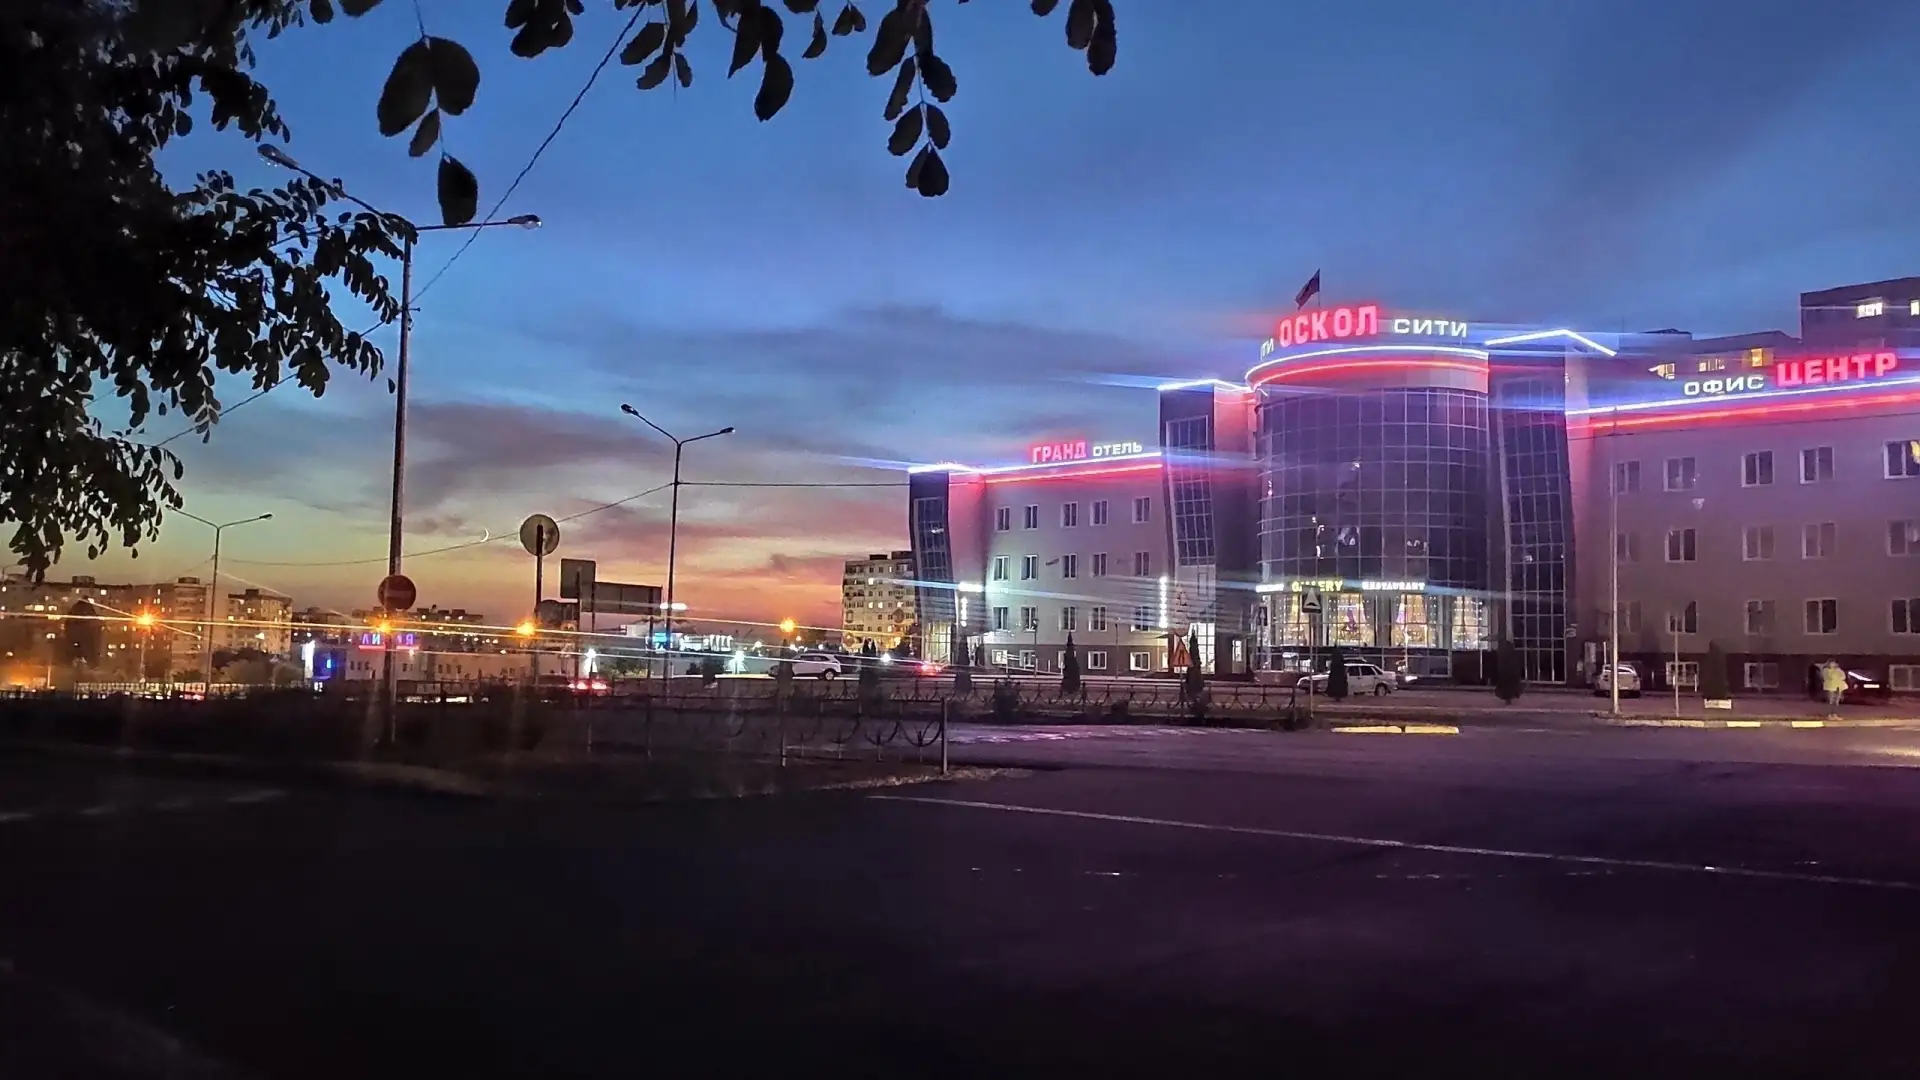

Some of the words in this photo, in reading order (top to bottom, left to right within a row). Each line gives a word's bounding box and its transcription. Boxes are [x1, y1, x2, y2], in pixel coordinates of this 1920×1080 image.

[1279, 305, 1377, 348] ОСКОЛ
[1393, 318, 1467, 338] СИТИ
[1684, 375, 1764, 396] ОФИС
[1776, 352, 1897, 388] ЦЕНТР
[1032, 442, 1087, 463] ГРАНД
[1092, 442, 1143, 457] ОТЕЛЬ
[1291, 580, 1343, 592] GERY
[362, 633, 414, 645] ЛИЯ
